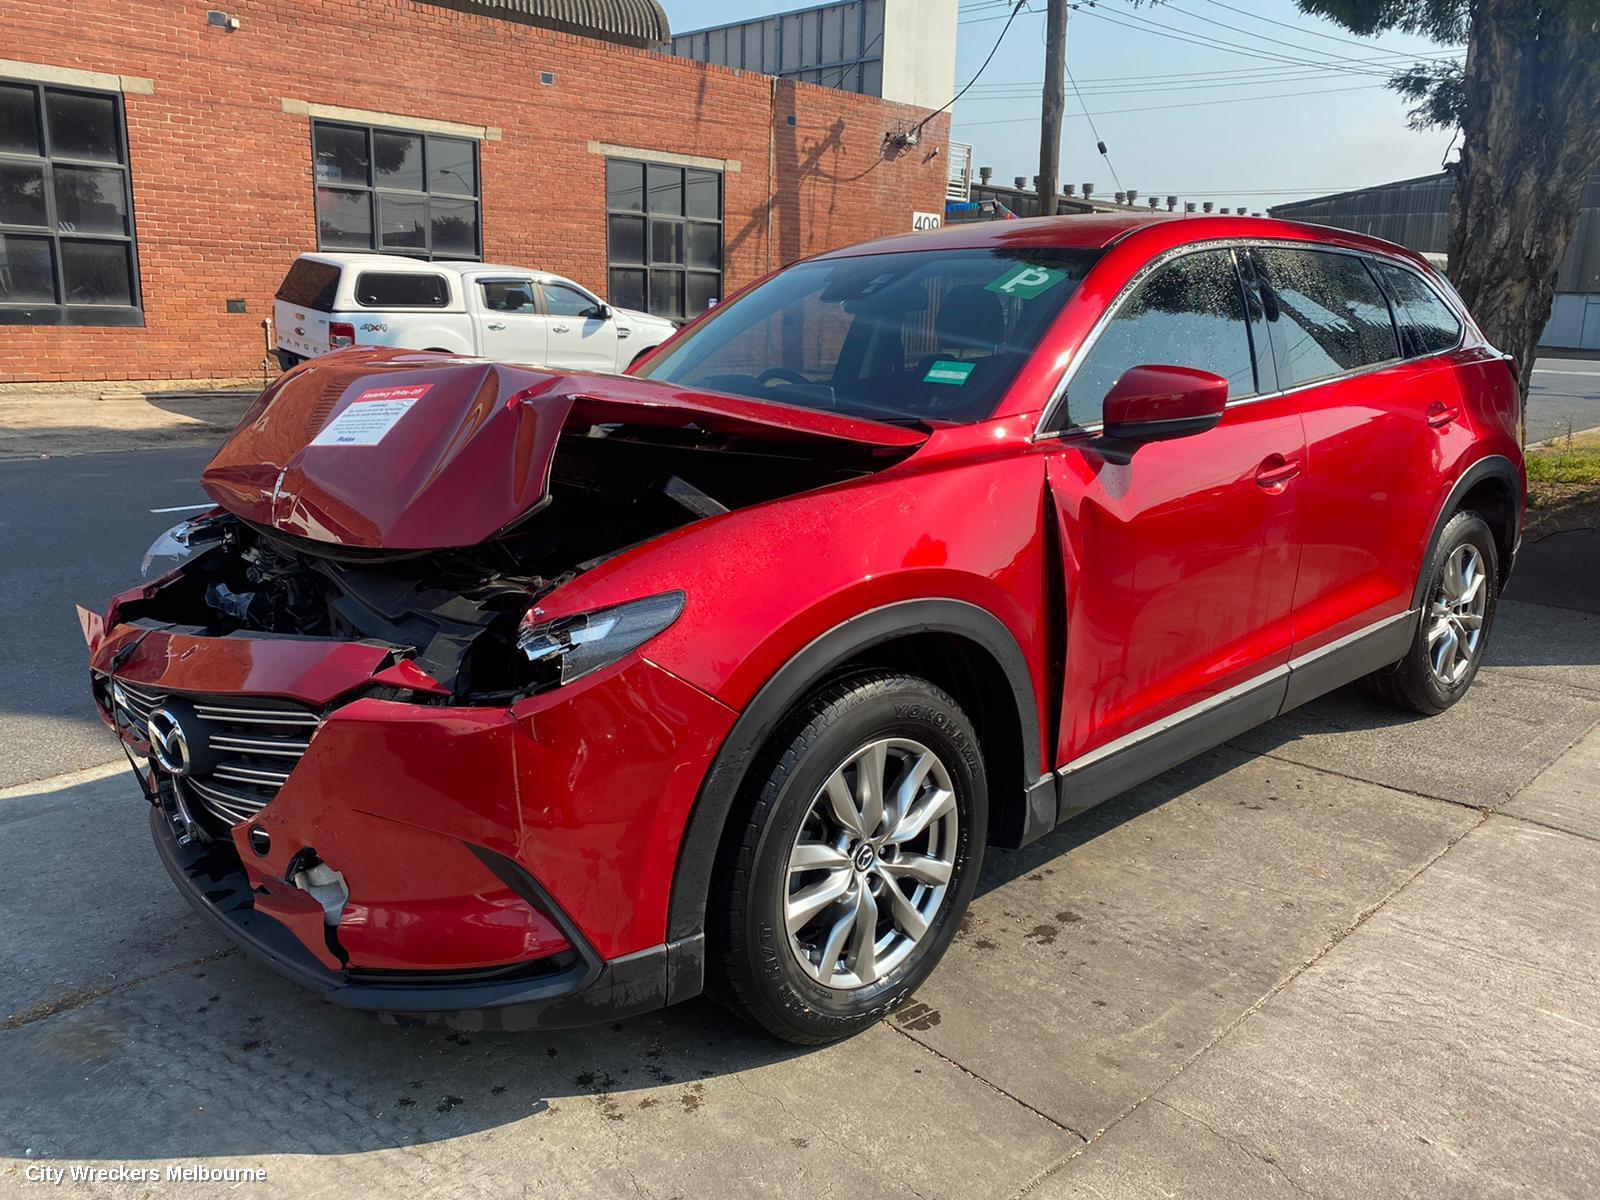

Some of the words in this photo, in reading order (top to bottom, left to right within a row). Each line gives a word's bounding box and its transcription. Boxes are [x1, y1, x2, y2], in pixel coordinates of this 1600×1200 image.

[915, 216, 939, 230] 409
[1000, 267, 1050, 290] P
[894, 703, 981, 779] YOKOHAMA
